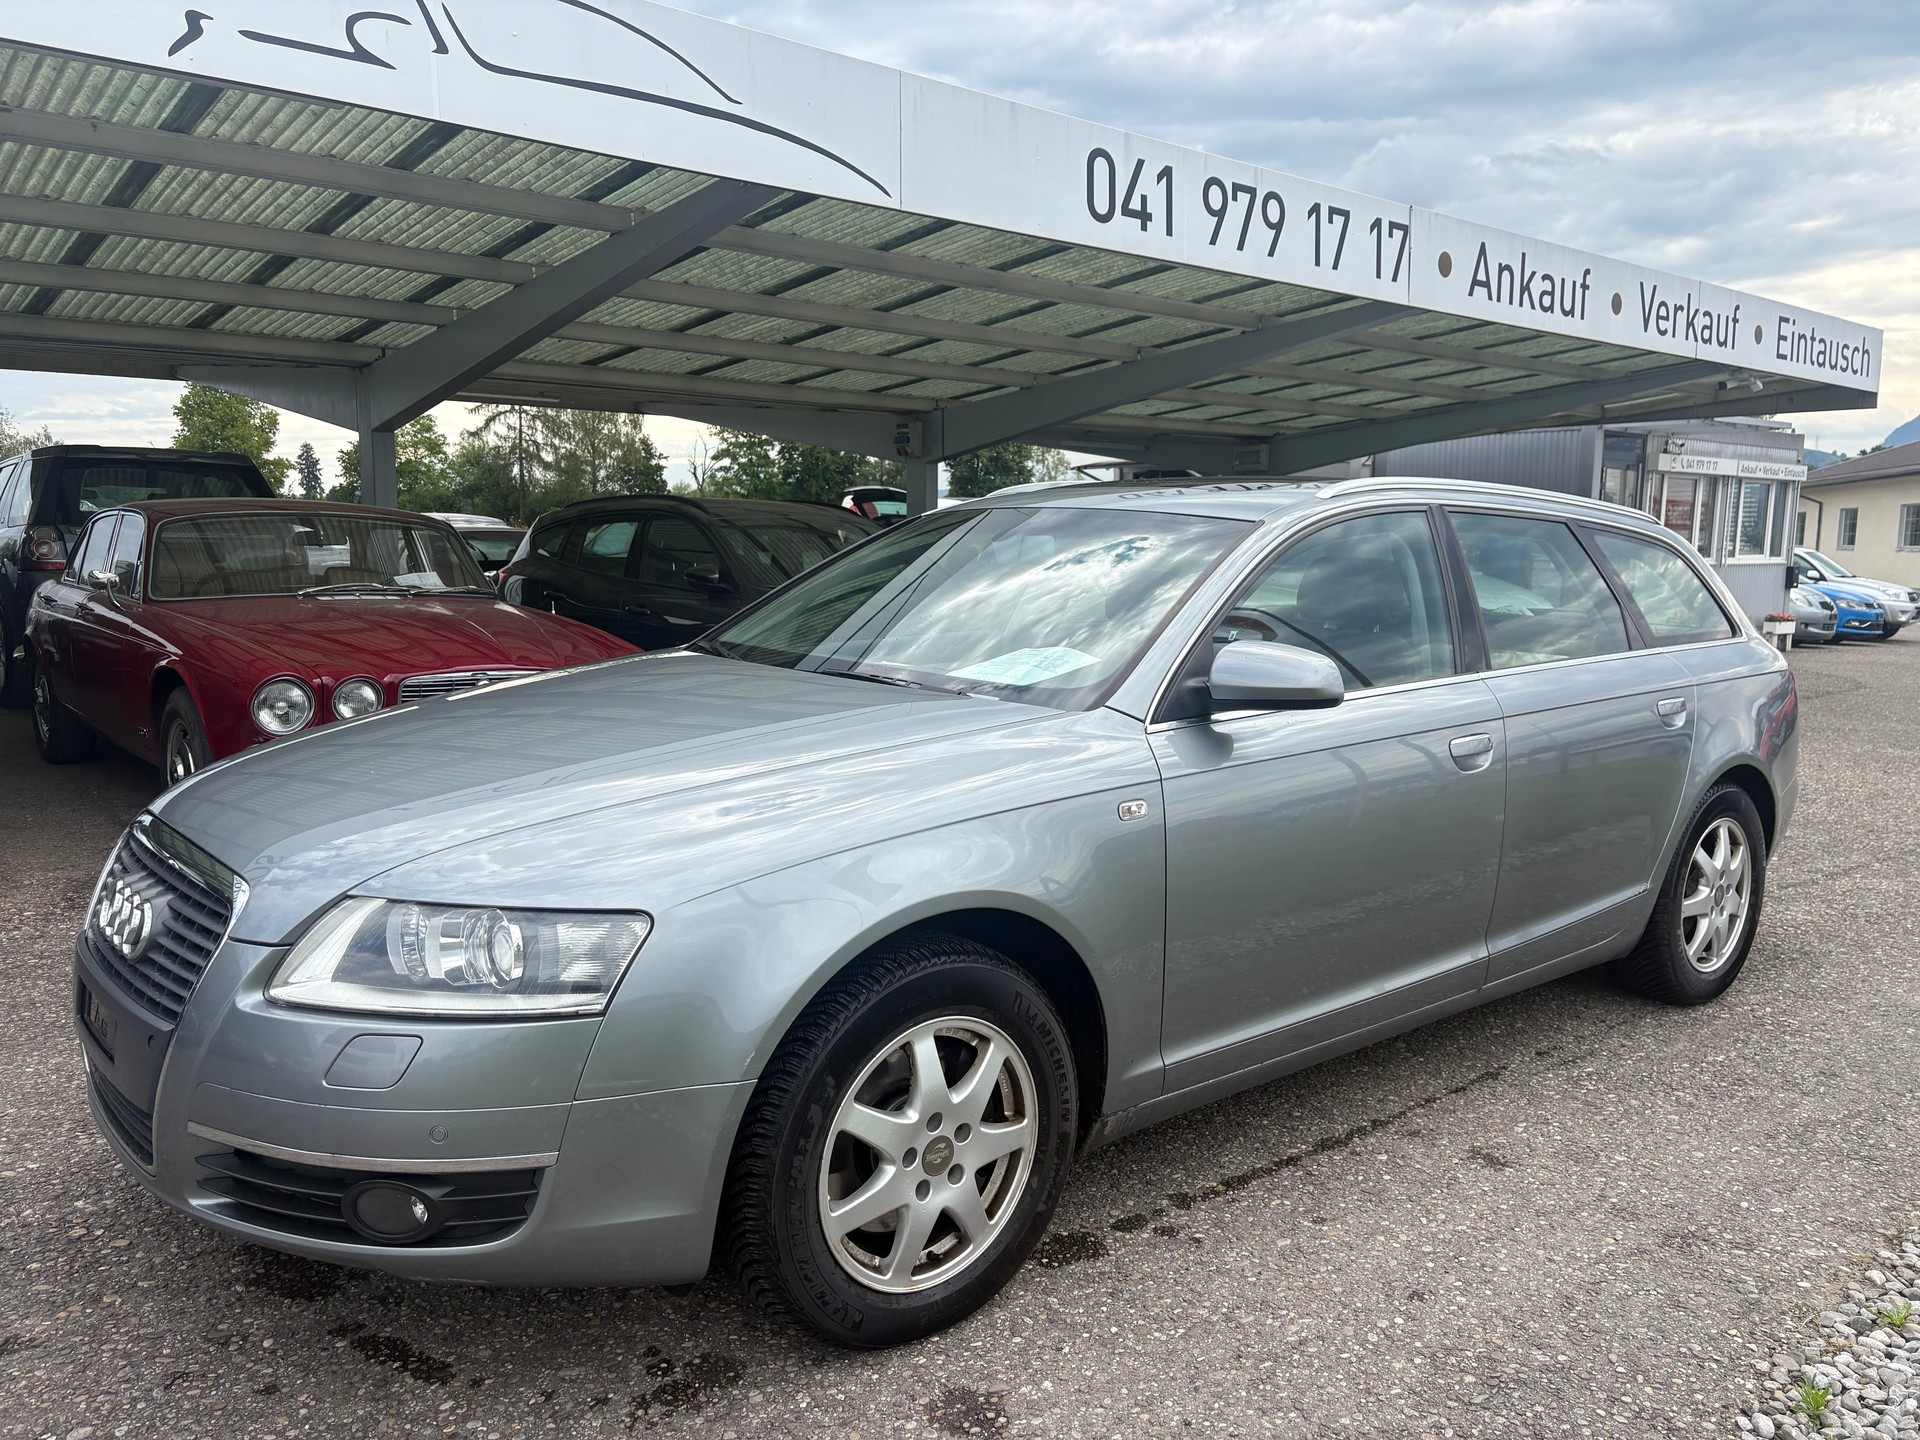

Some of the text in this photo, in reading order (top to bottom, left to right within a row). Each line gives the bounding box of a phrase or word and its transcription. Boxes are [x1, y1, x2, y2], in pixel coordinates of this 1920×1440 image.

[1086, 147, 1871, 378] 041 979 17 17 Ankauf Verkauf Eintausch
[1686, 459, 1805, 478] 041 979 17 17 Ankauf Verkauf Eintausch
[1034, 1020, 1071, 1123] MICHELIN
